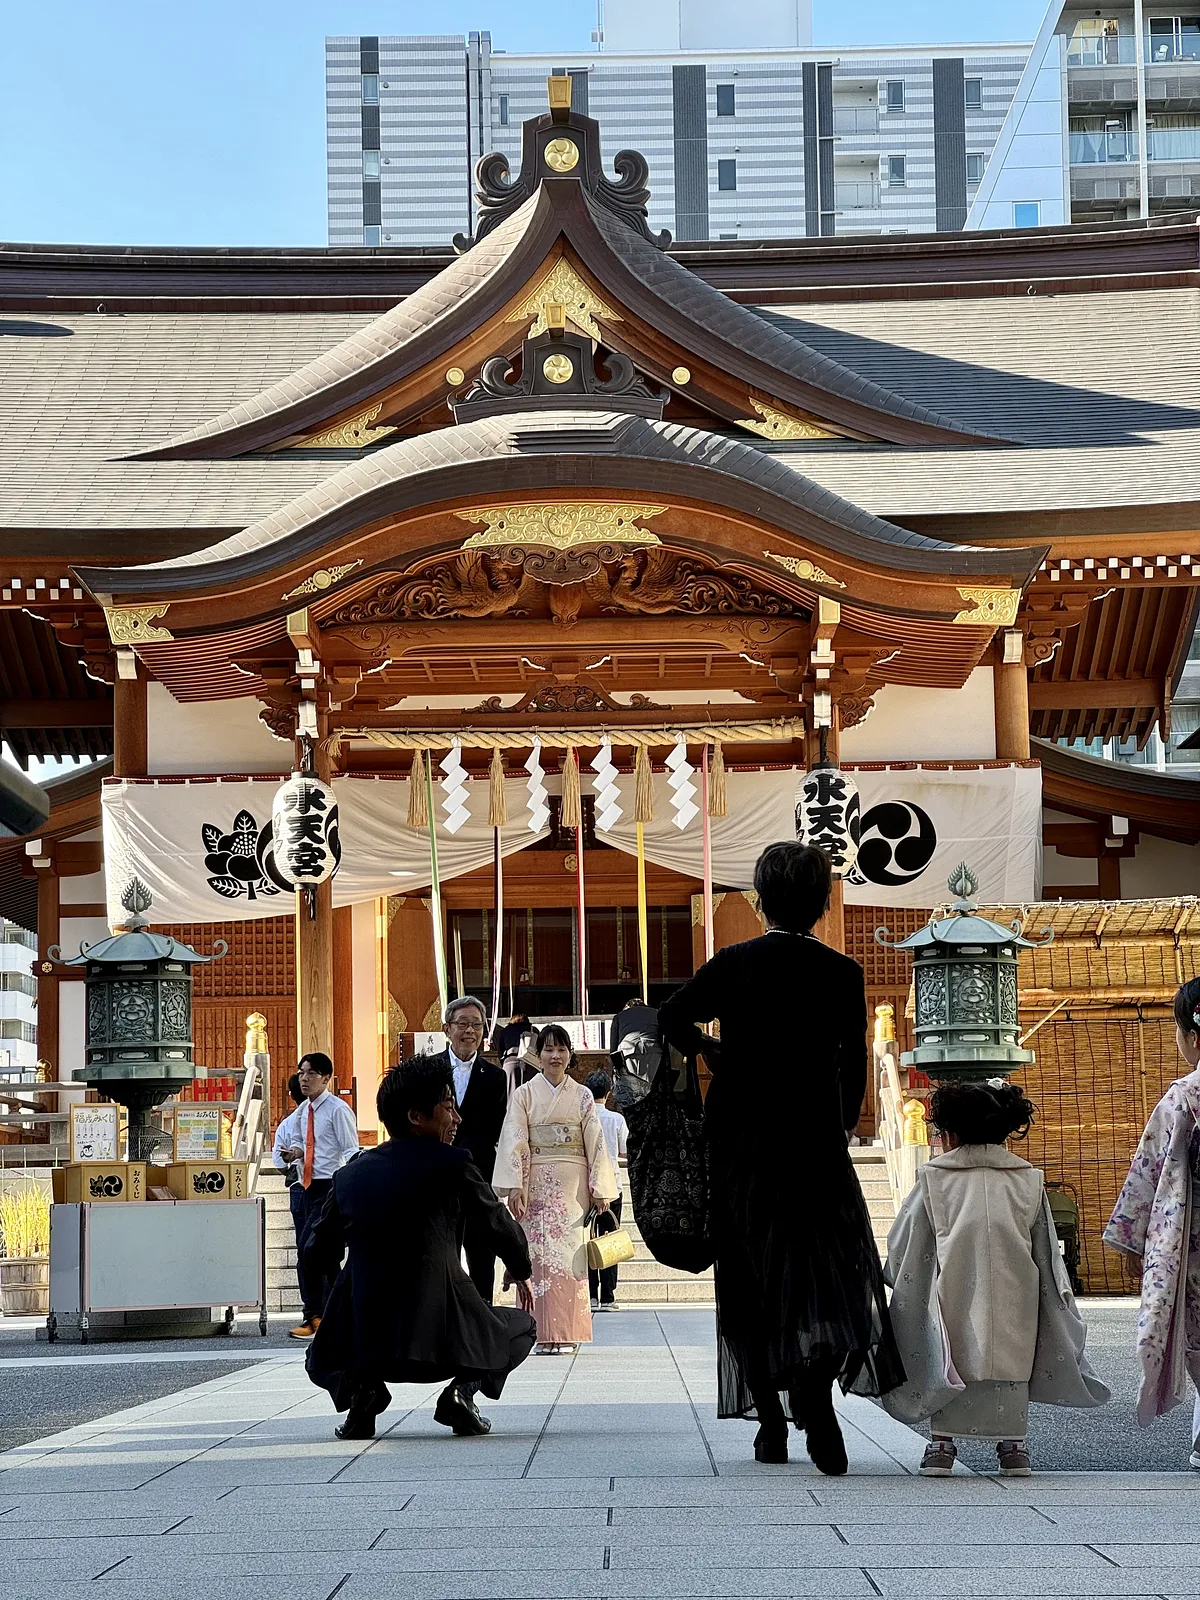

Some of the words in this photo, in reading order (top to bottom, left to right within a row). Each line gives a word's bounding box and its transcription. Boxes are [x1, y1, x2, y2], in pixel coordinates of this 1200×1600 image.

[283, 782, 328, 877] 水天宮
[803, 773, 848, 867] 水天宮
[196, 1111, 218, 1119] おみくじ
[133, 1170, 141, 1199] おみくじ
